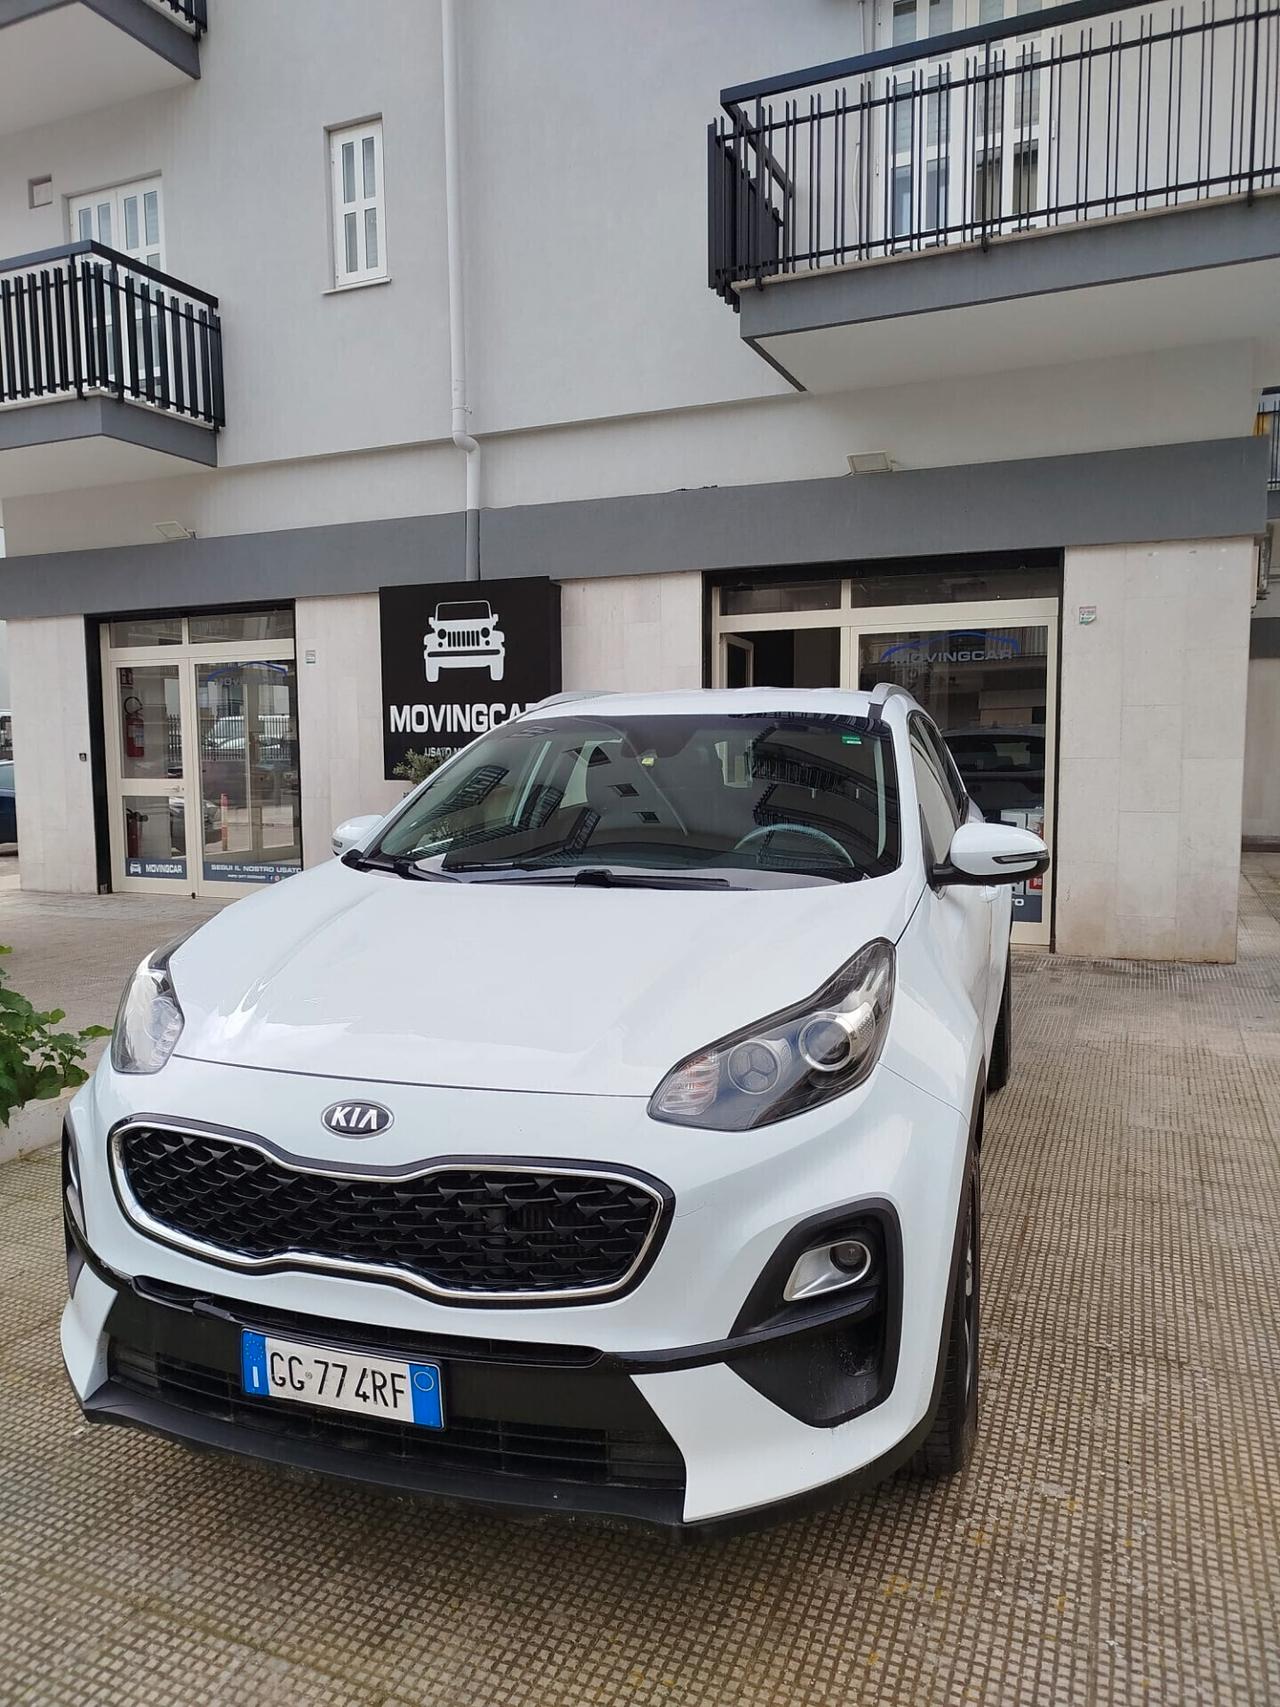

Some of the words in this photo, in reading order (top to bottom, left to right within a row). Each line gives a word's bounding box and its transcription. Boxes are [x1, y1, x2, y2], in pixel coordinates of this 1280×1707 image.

[389, 702, 537, 733] MOVINGCA
[145, 863, 183, 874] MOVINGCAR
[243, 865, 275, 873] NOSTRO
[331, 1106, 378, 1130] KIA
